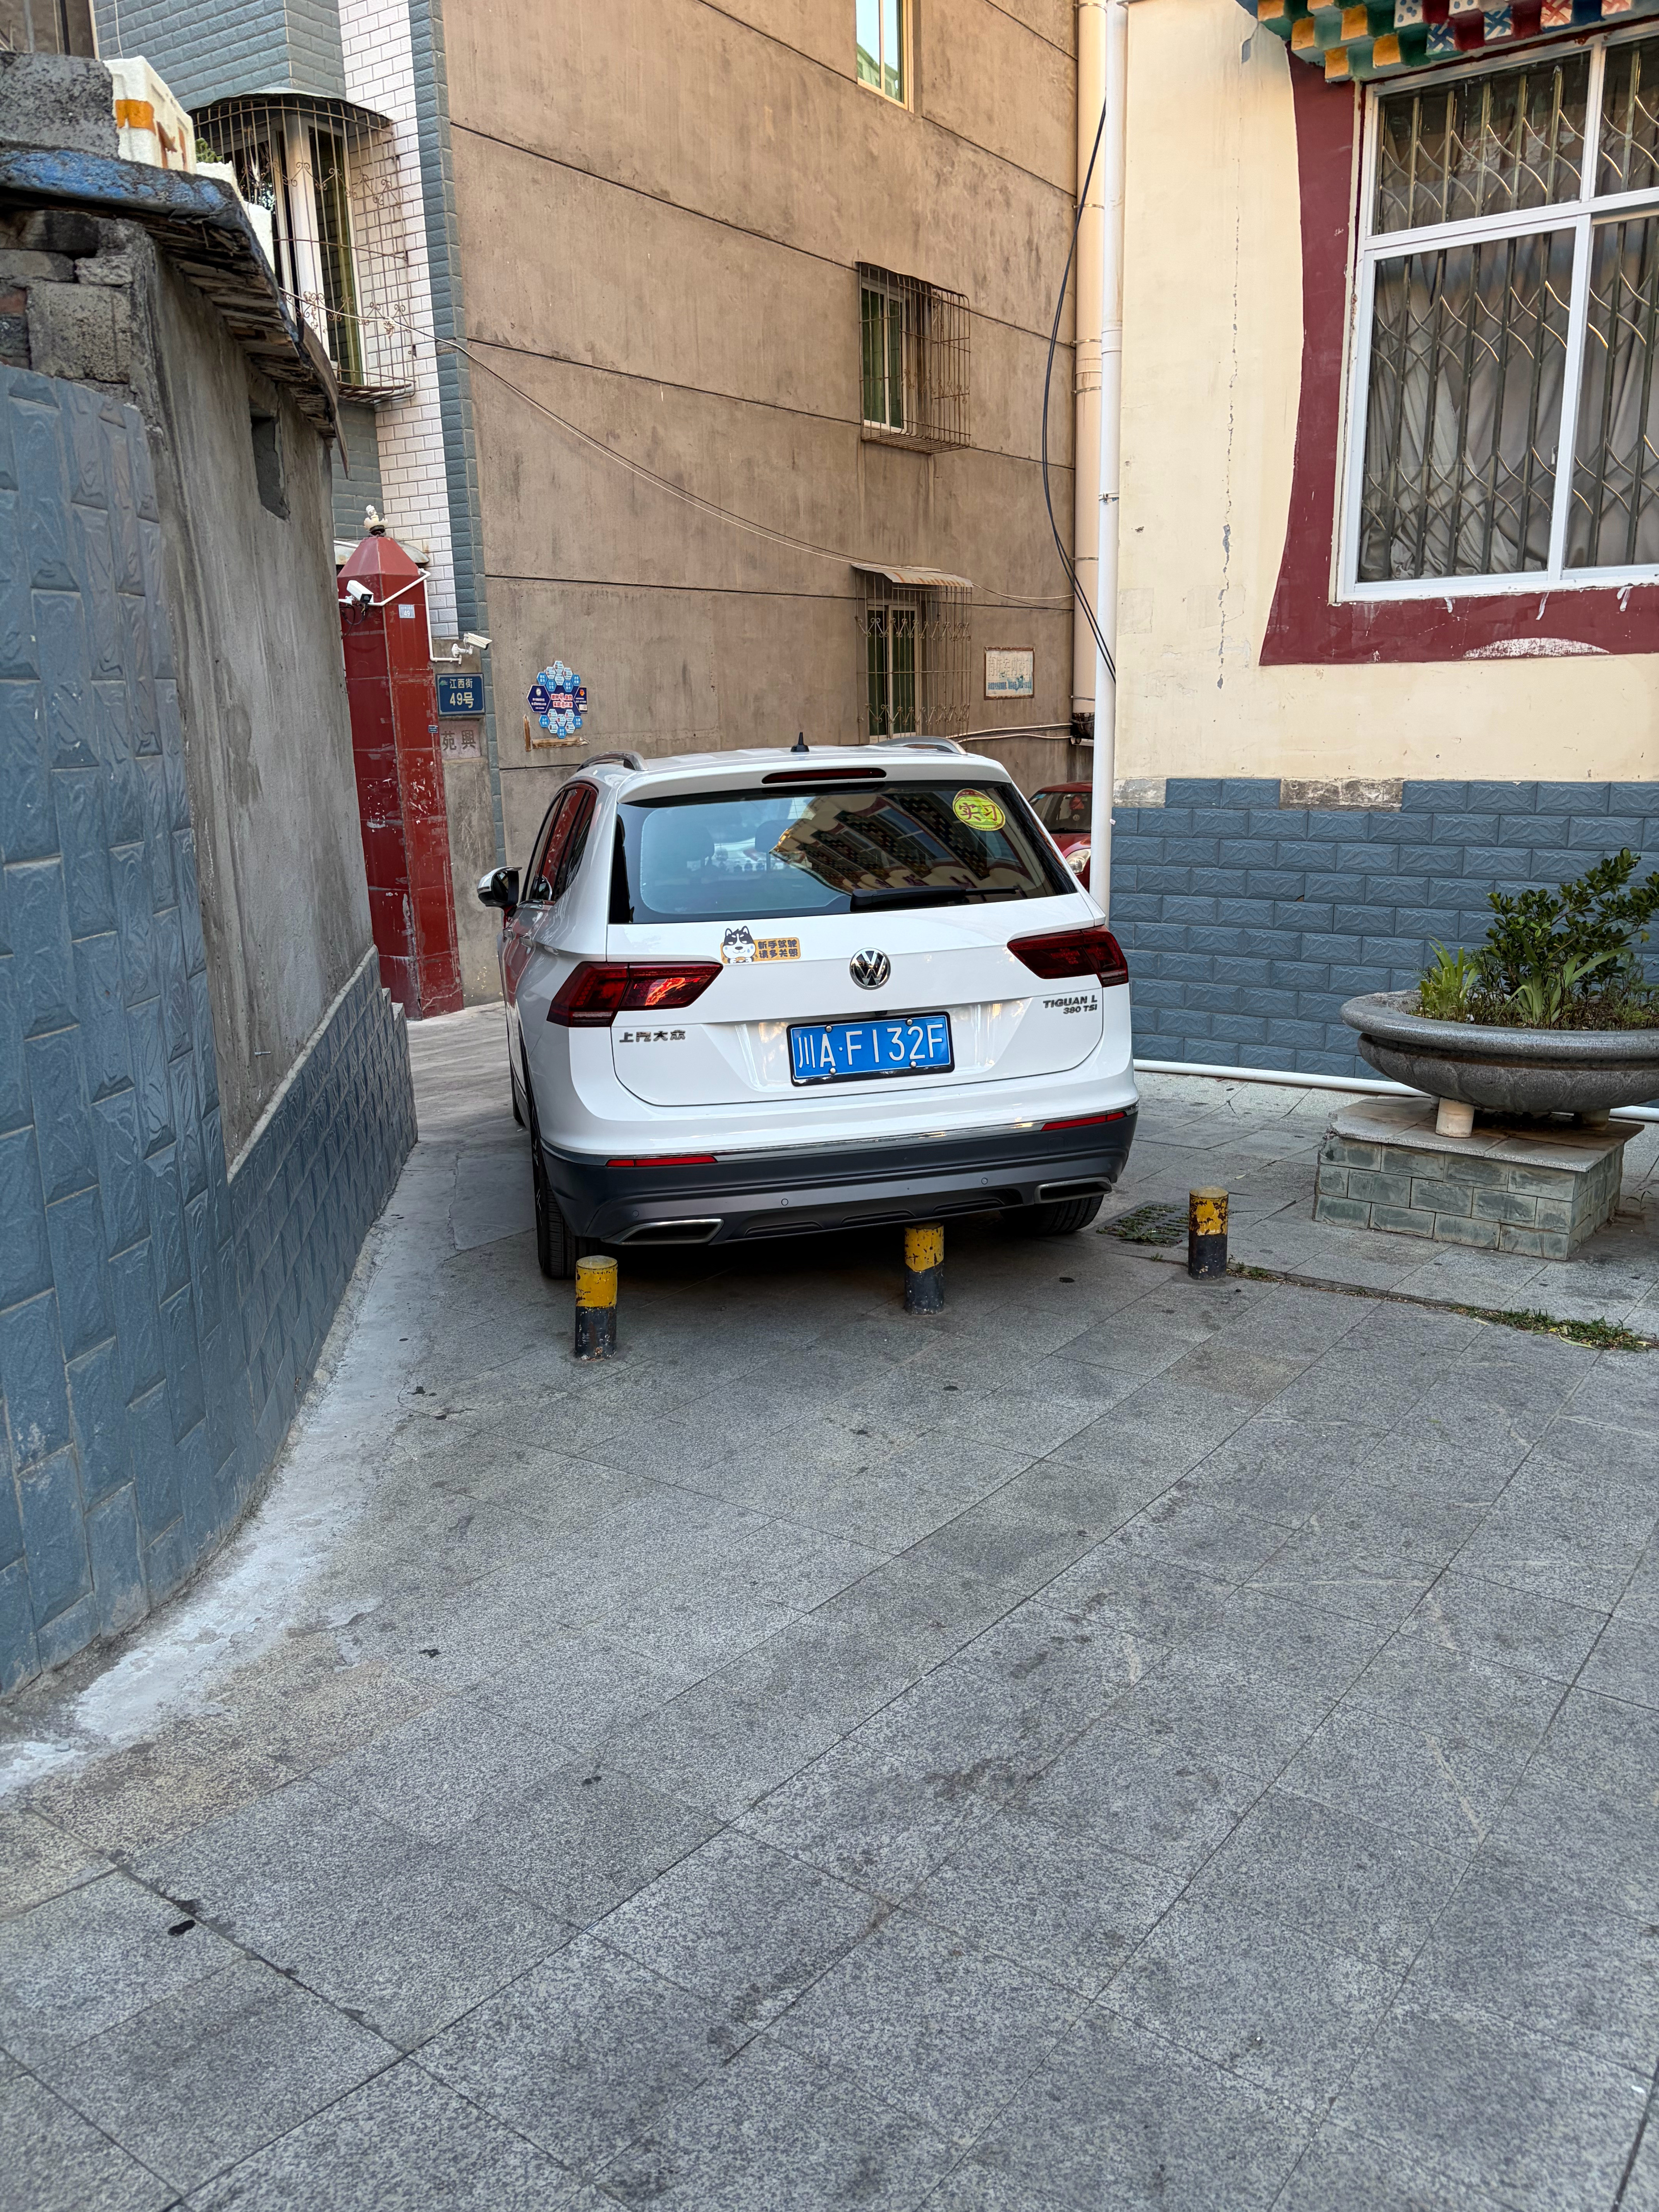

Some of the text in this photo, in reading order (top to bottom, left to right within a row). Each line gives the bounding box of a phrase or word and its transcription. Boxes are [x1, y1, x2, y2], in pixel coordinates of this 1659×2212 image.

[449, 678, 473, 689] 江西街
[450, 692, 474, 709] 49号
[958, 802, 998, 821] 实习
[757, 939, 797, 950] 新手驾驶
[759, 948, 798, 959] 请多关照
[1042, 994, 1098, 1008] TIGUAN L
[1063, 1004, 1097, 1014] 380 TSI
[619, 1029, 686, 1042] 上汽大众
